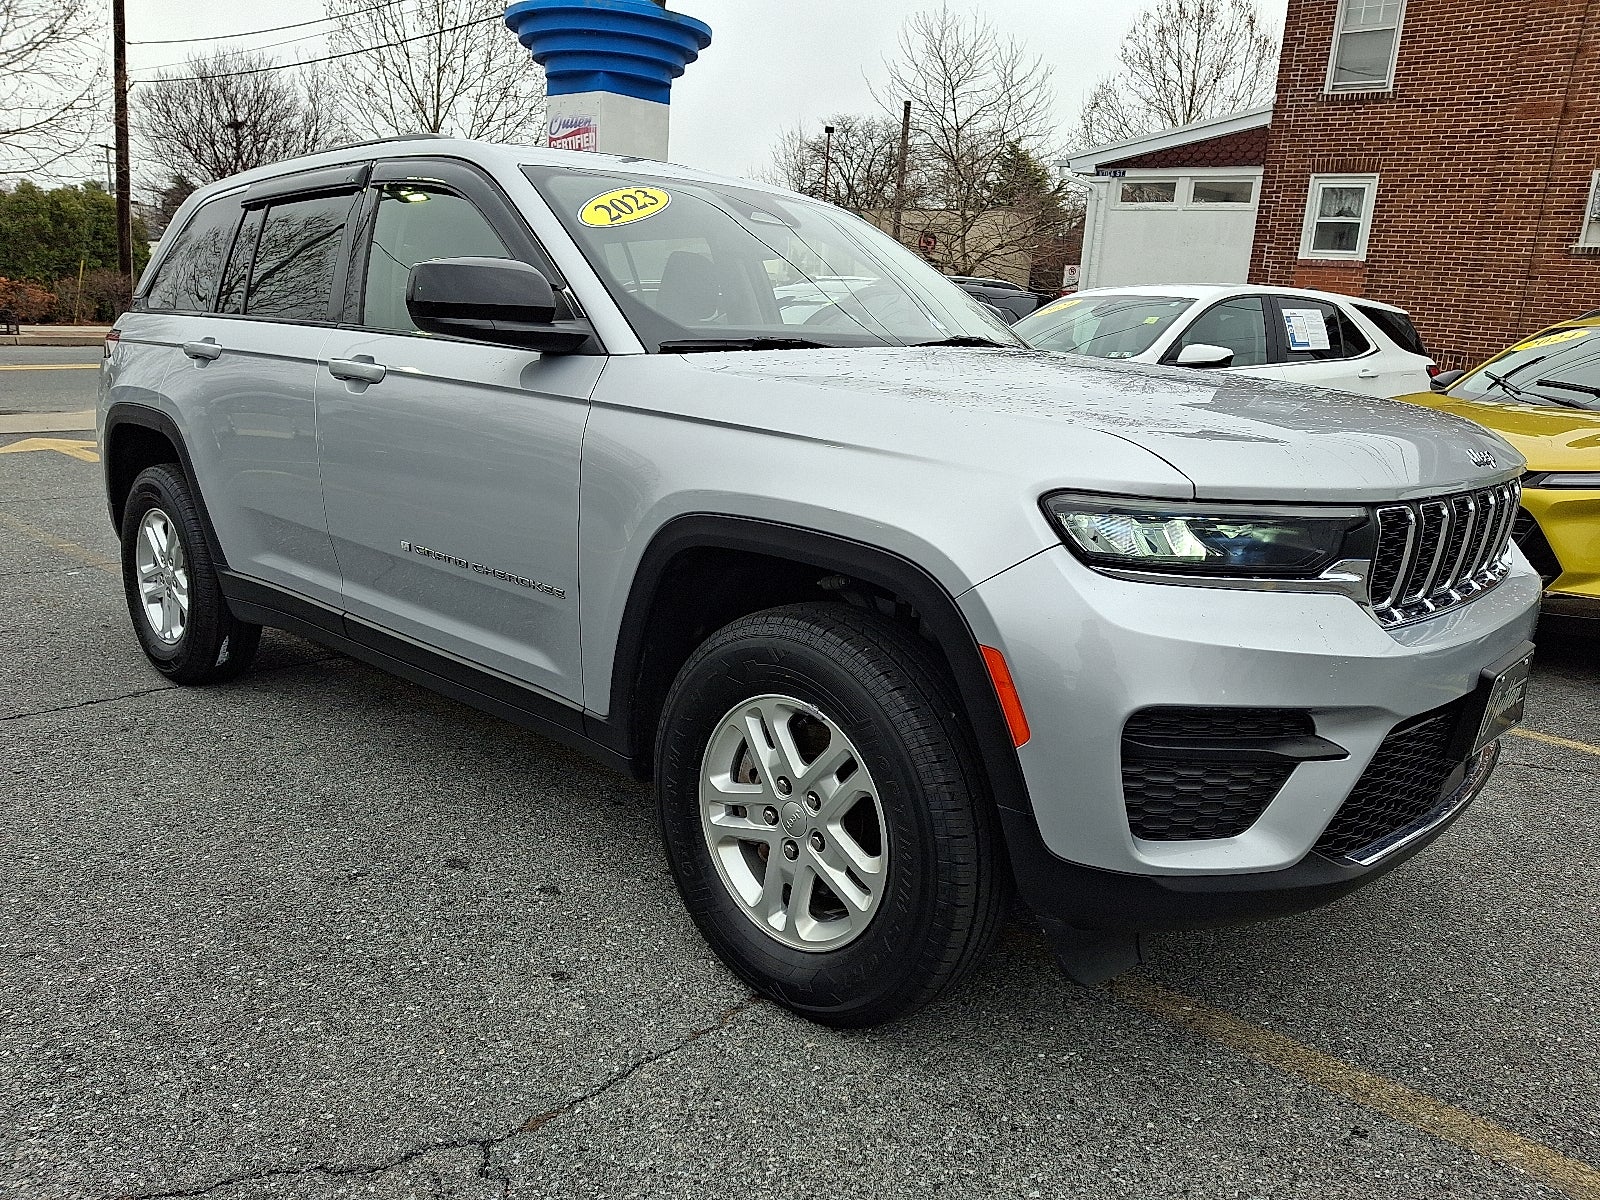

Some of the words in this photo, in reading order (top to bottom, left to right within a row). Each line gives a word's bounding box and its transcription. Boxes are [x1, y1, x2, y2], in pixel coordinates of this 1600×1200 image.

[550, 132, 594, 151] CERTIFIED
[594, 189, 659, 222] 2023
[1466, 448, 1498, 470] Jeep
[414, 545, 468, 568] GRAND
[472, 562, 566, 600] CHEROKEE
